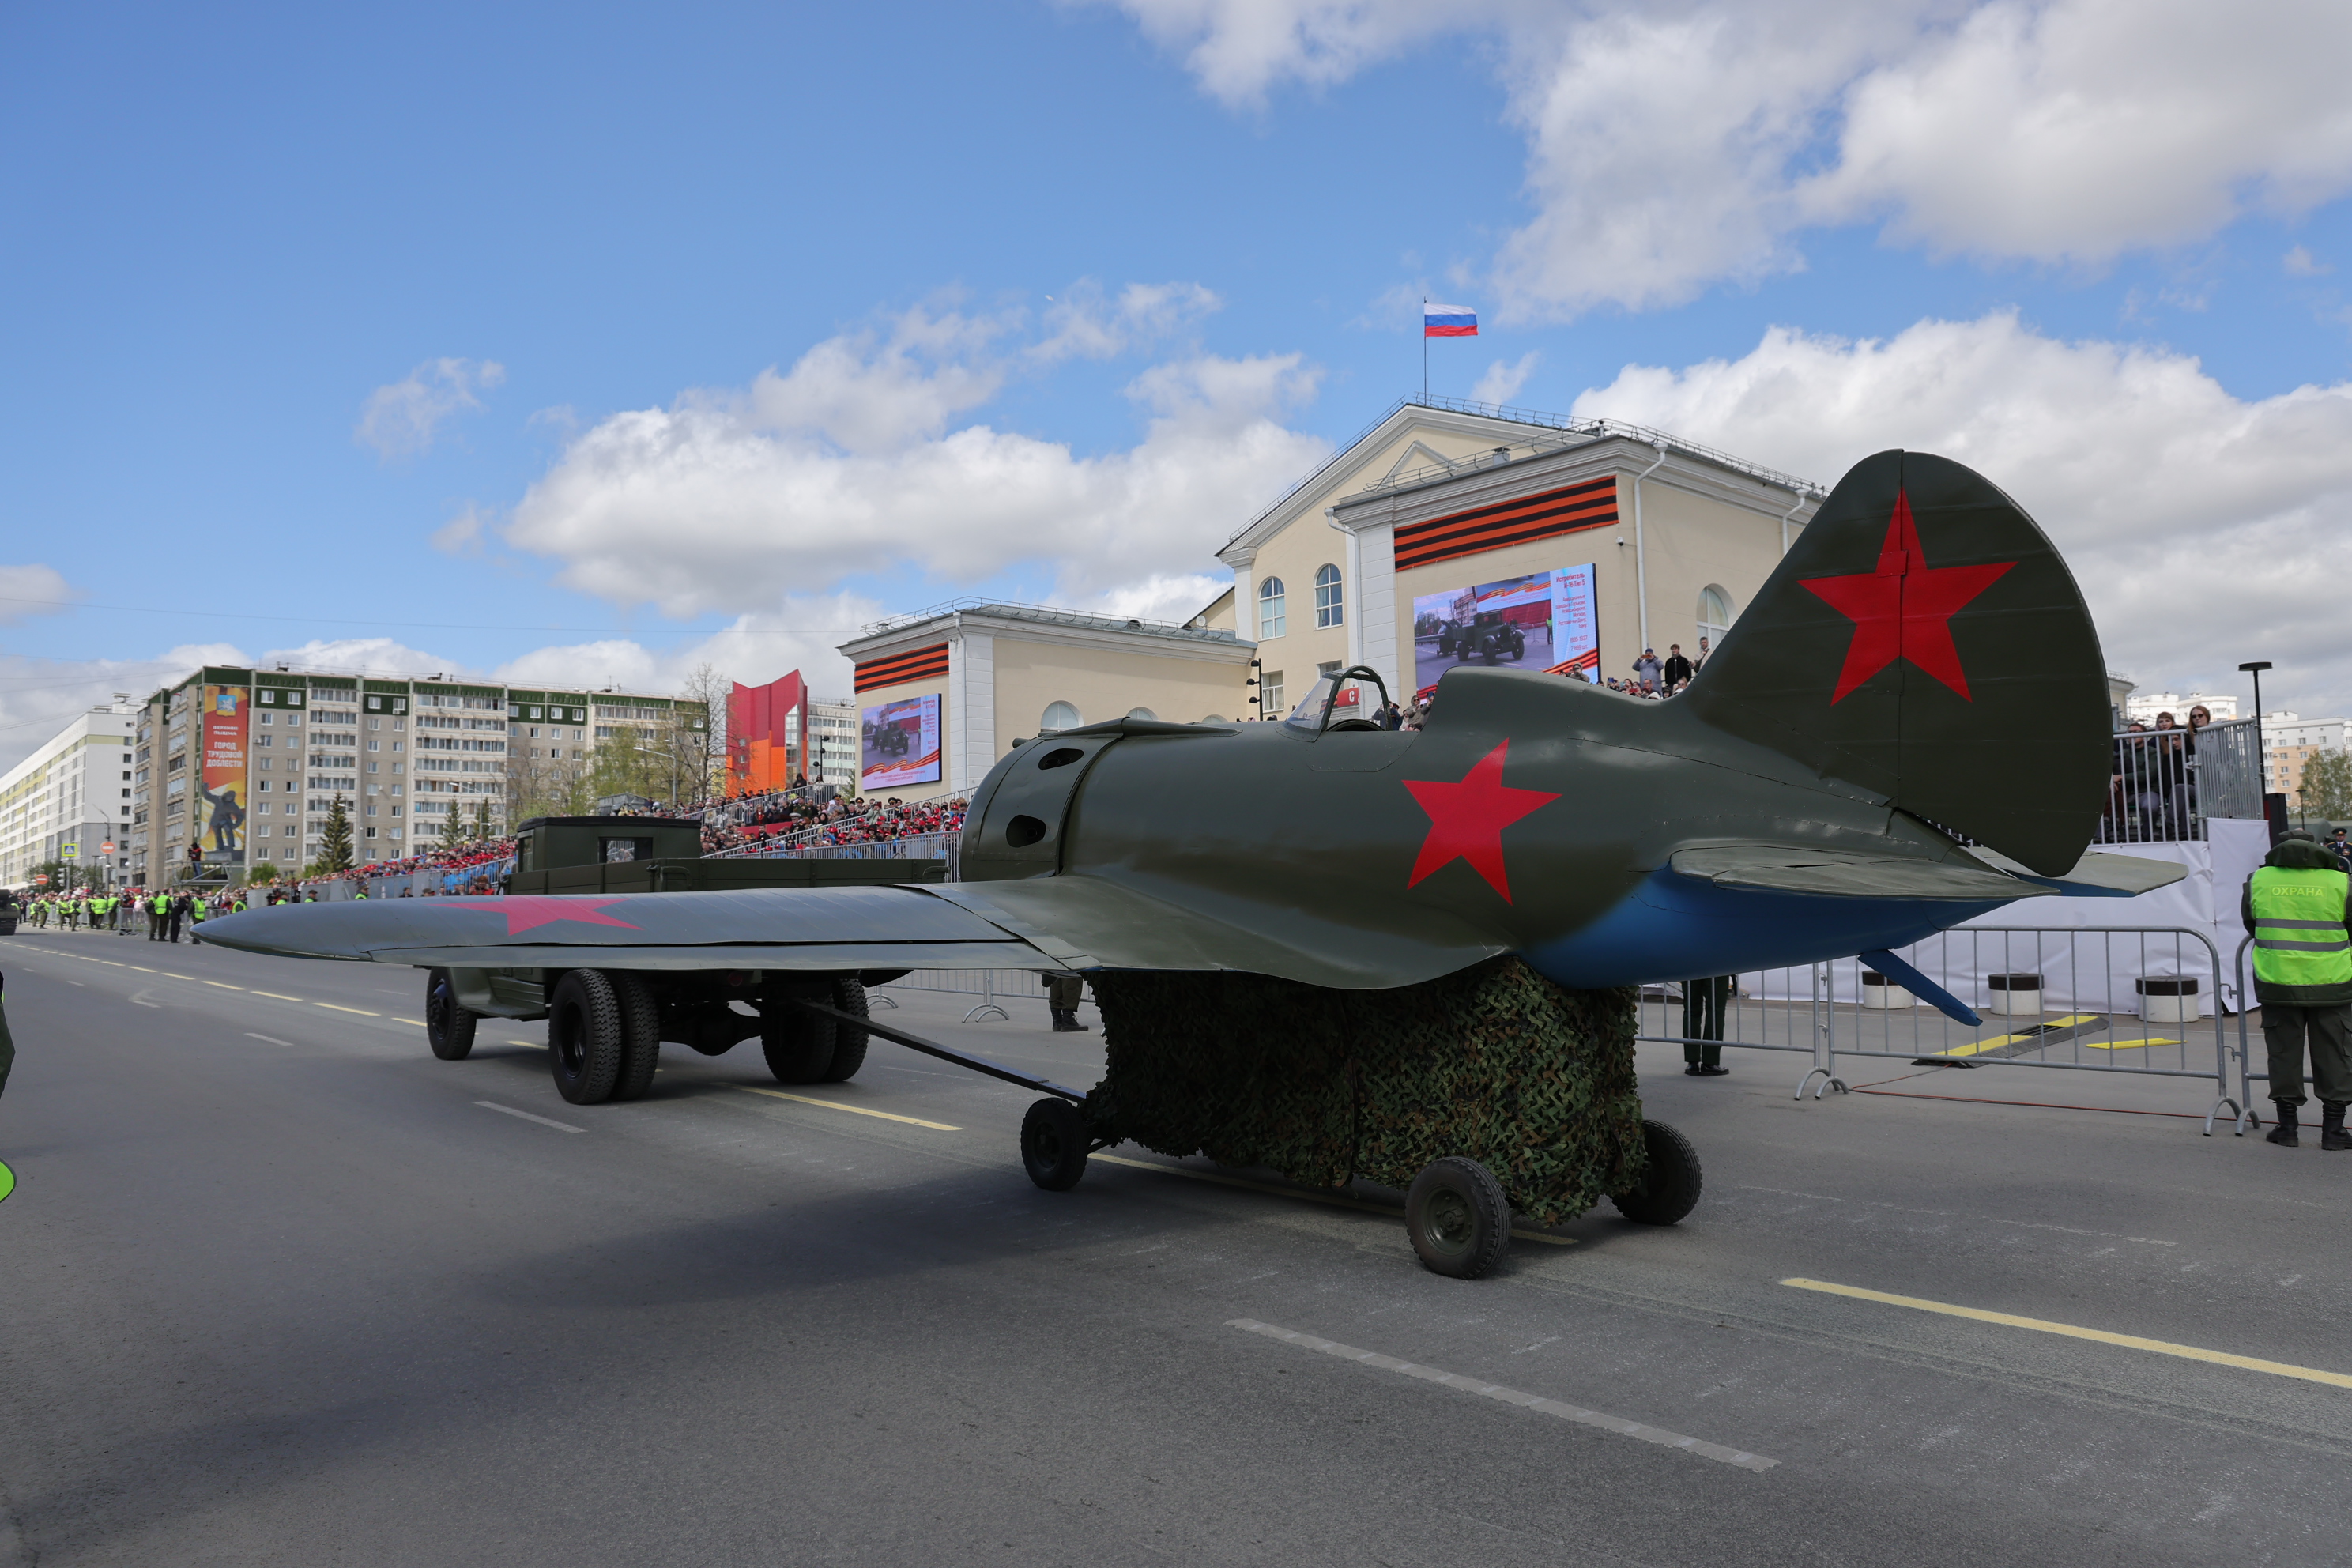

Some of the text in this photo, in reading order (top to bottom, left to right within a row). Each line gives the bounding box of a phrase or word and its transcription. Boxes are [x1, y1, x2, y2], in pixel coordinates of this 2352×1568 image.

[1556, 573, 1585, 582] Истребитель
[214, 741, 236, 750] ГОРОД
[207, 750, 243, 759] ТРУДОВОЙ
[2271, 887, 2324, 896] ОХРАНА
